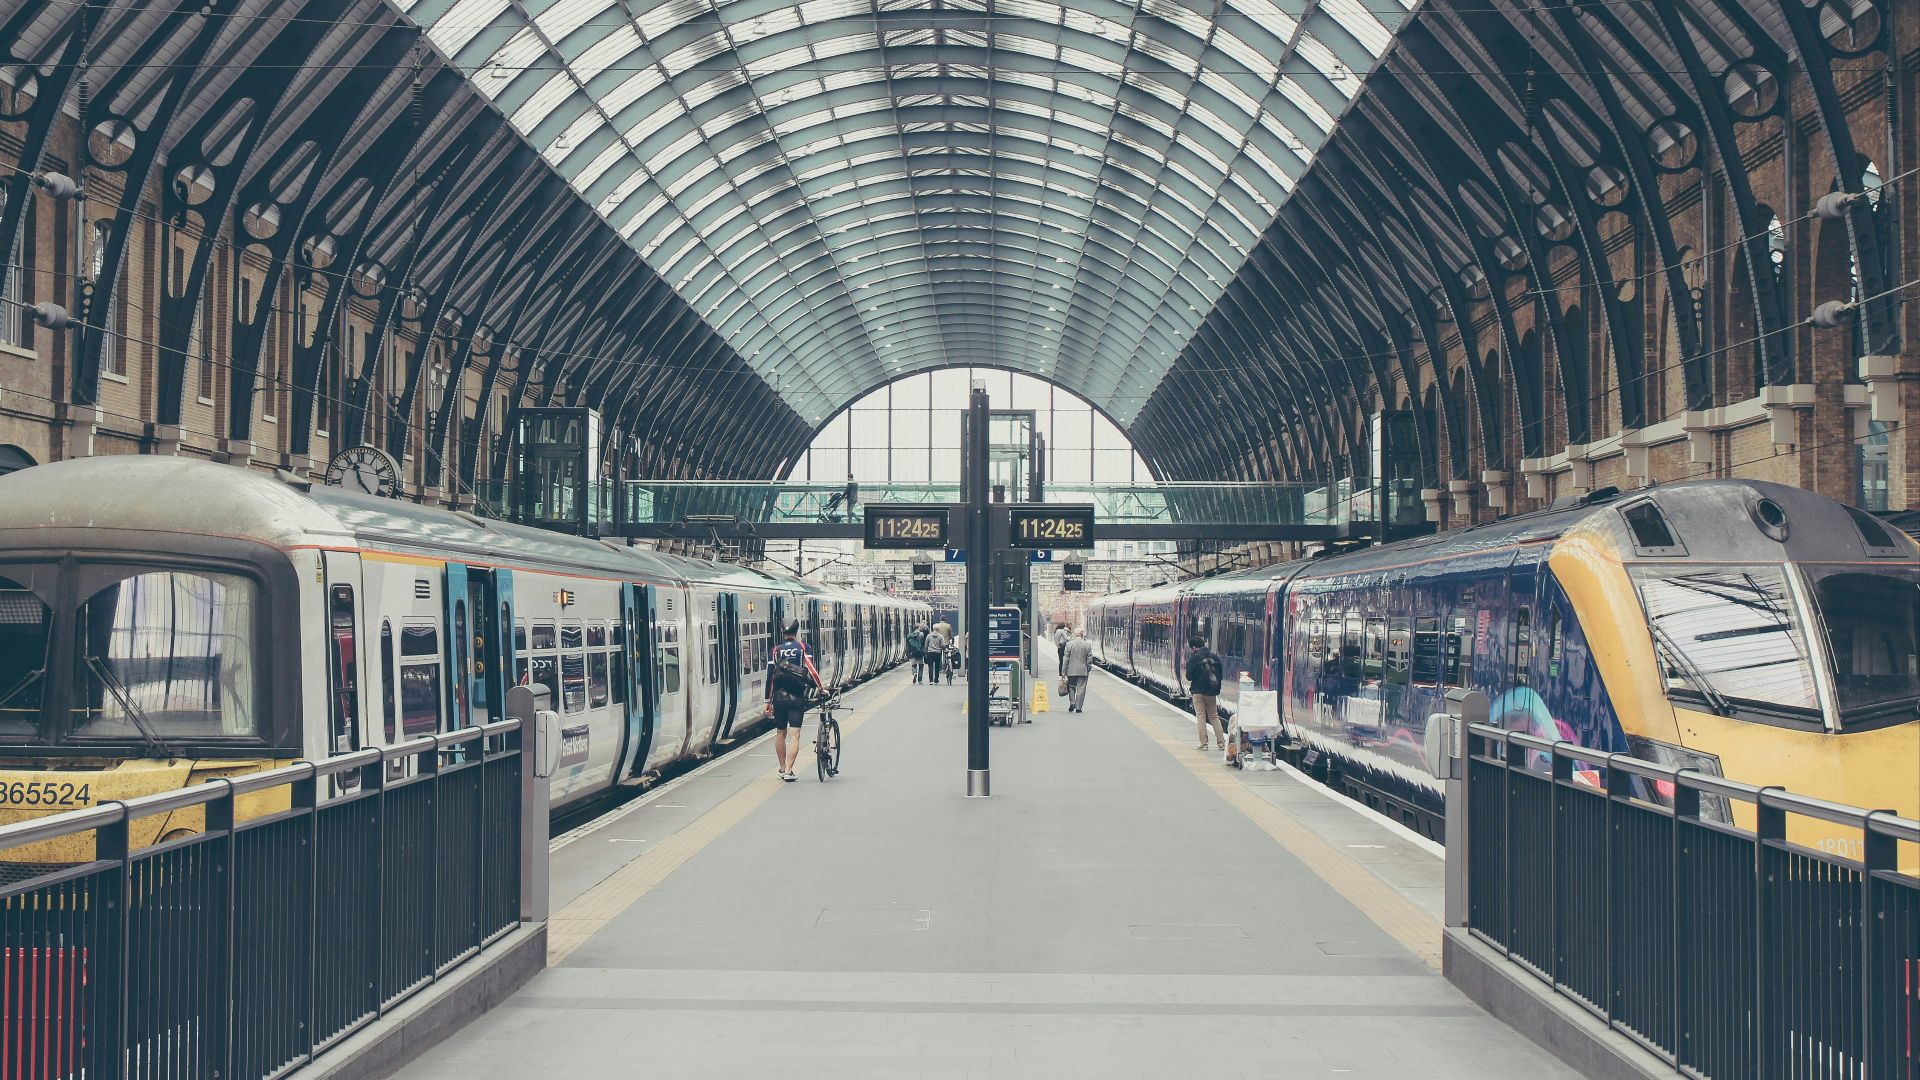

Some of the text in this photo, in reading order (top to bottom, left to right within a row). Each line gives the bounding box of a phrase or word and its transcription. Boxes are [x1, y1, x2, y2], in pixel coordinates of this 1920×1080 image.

[951, 549, 959, 559] 7
[1037, 550, 1045, 559] 6
[780, 648, 798, 657] TCC
